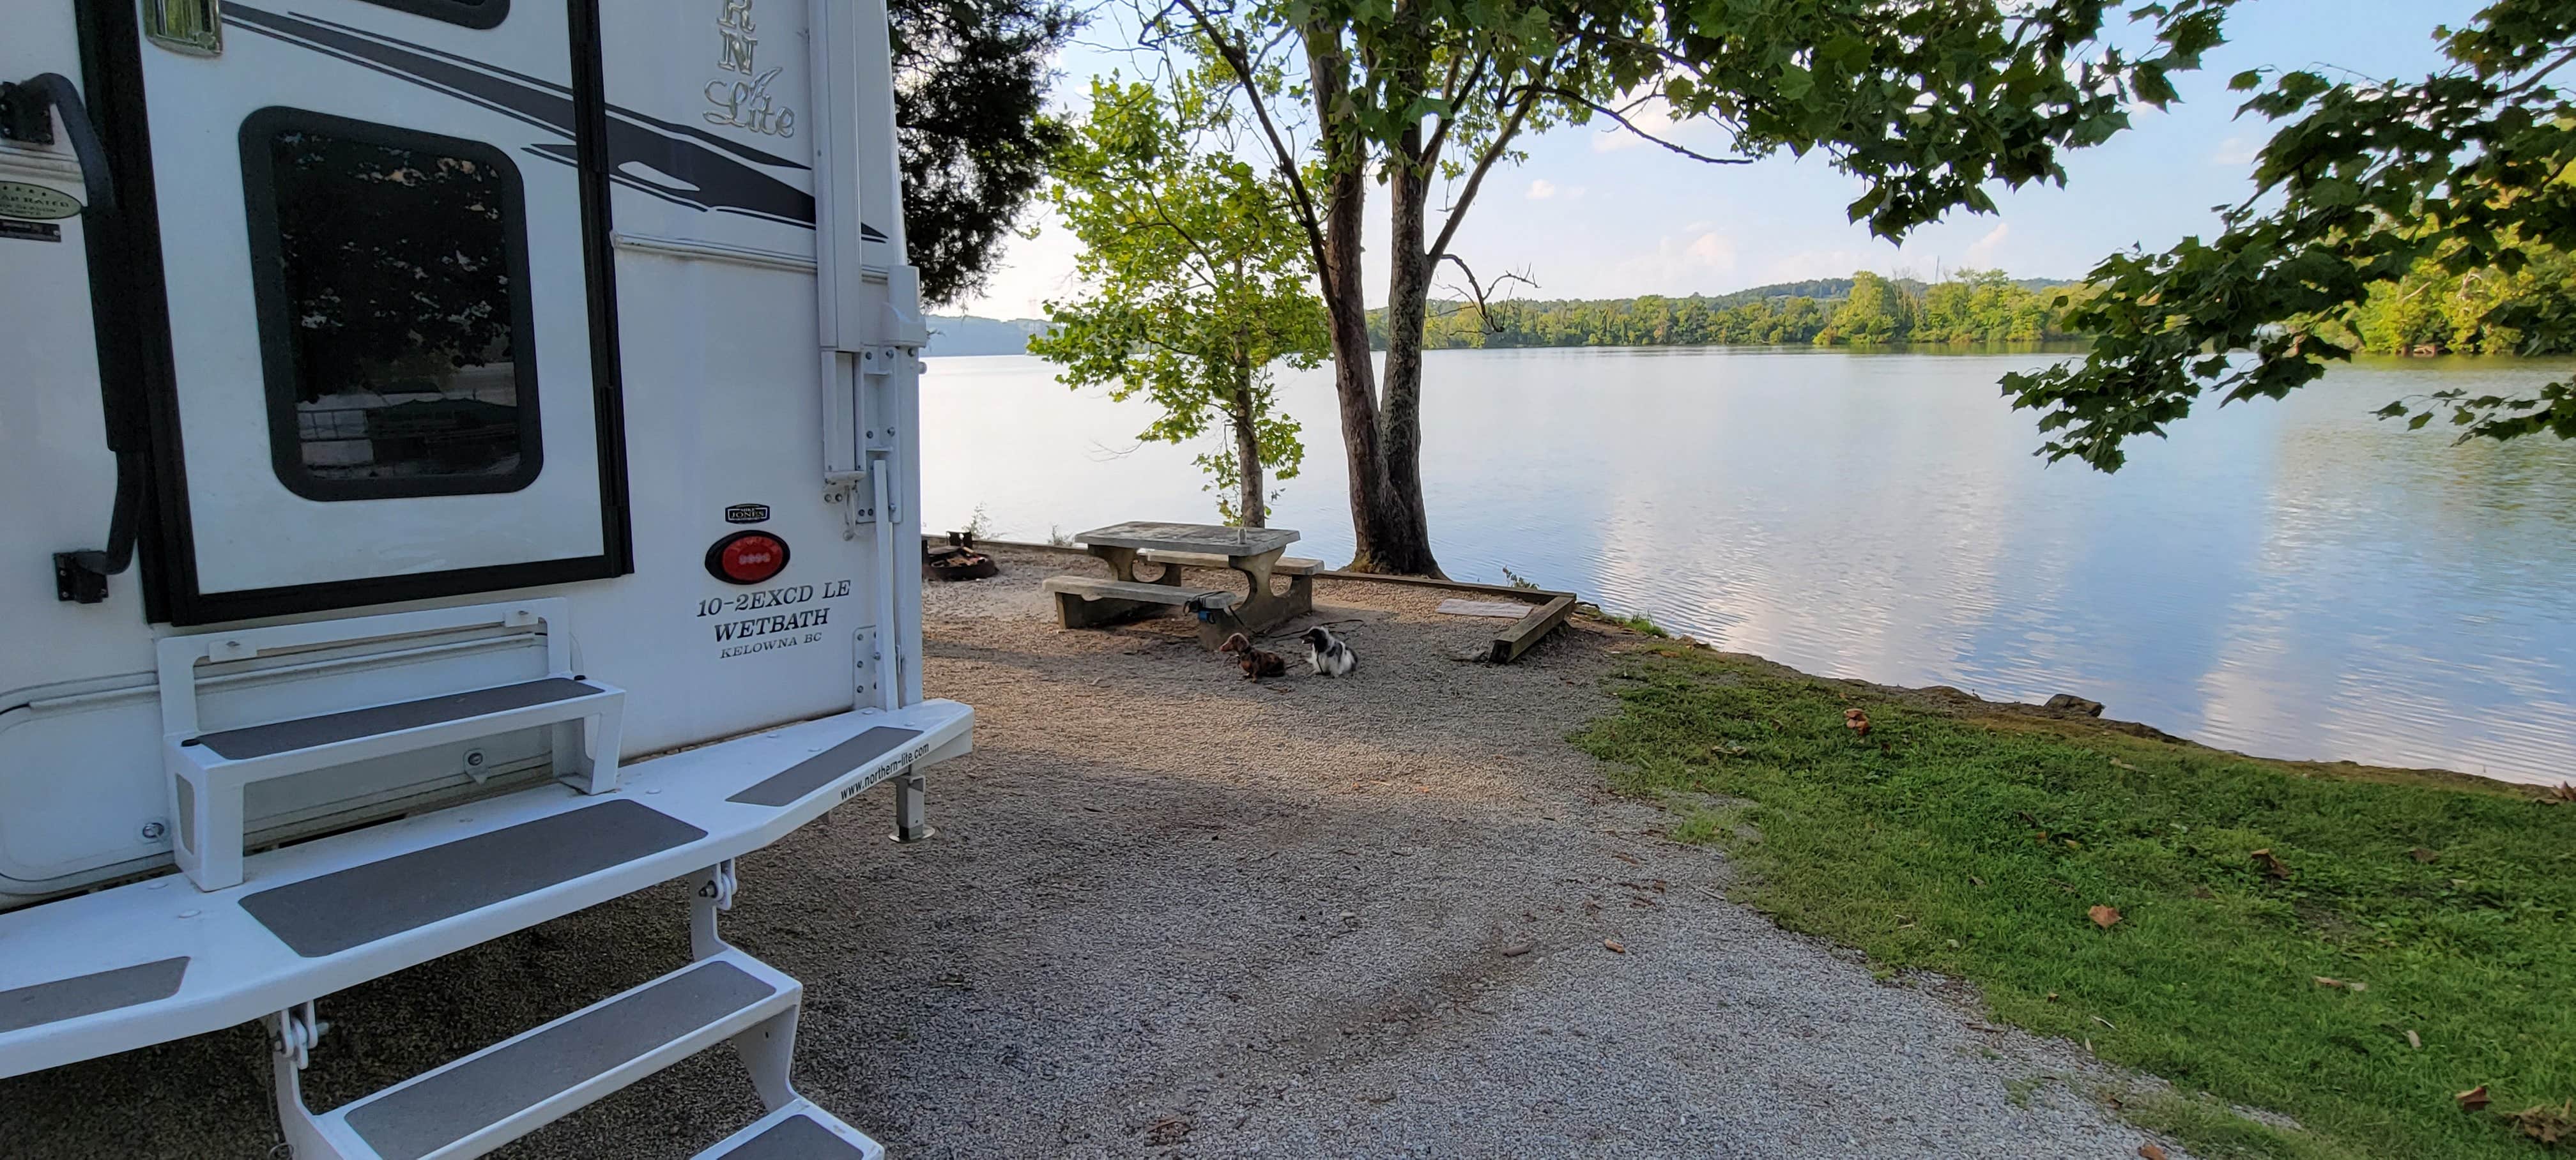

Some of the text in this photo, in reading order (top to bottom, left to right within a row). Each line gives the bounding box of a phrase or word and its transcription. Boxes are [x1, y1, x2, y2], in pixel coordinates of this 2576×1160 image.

[703, 66, 795, 138] Lite
[696, 579, 851, 618] 10-2EXCD LE
[714, 607, 831, 643] WETBATH
[719, 632, 822, 659] KELOWNA BC
[840, 742, 930, 800] www.northern-lite.com
